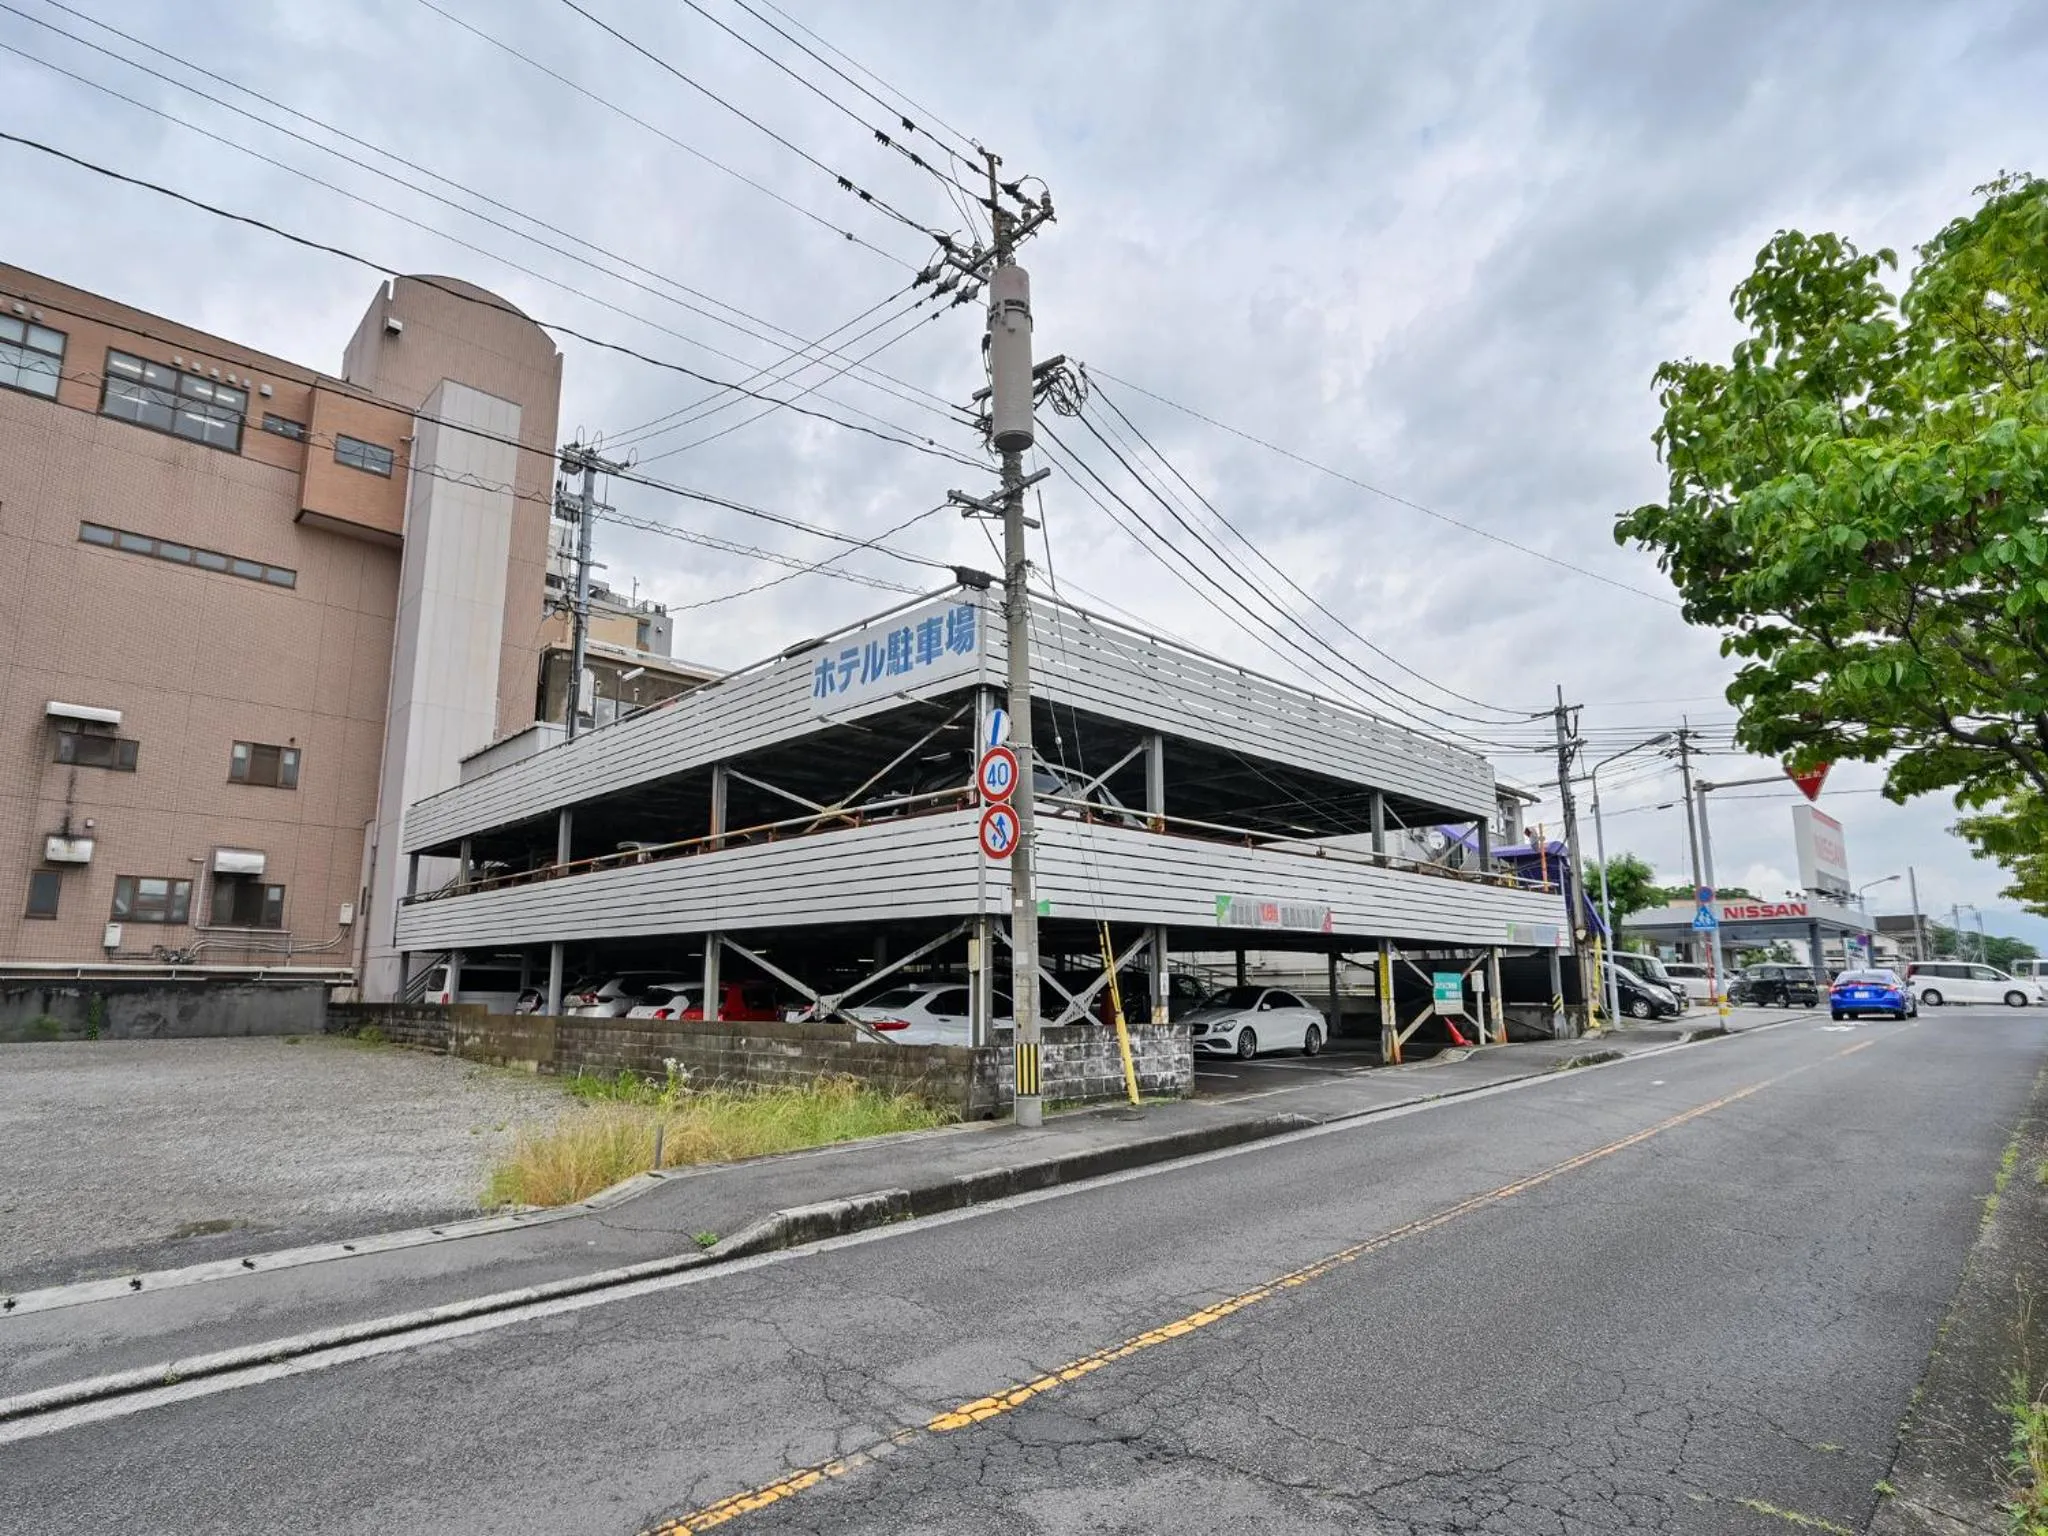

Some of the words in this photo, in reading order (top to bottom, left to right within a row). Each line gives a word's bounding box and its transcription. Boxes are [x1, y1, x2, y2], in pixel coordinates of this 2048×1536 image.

[813, 603, 975, 698] ホテル駐車場
[987, 763, 1009, 787] 40
[1724, 904, 1807, 919] NISSAN
